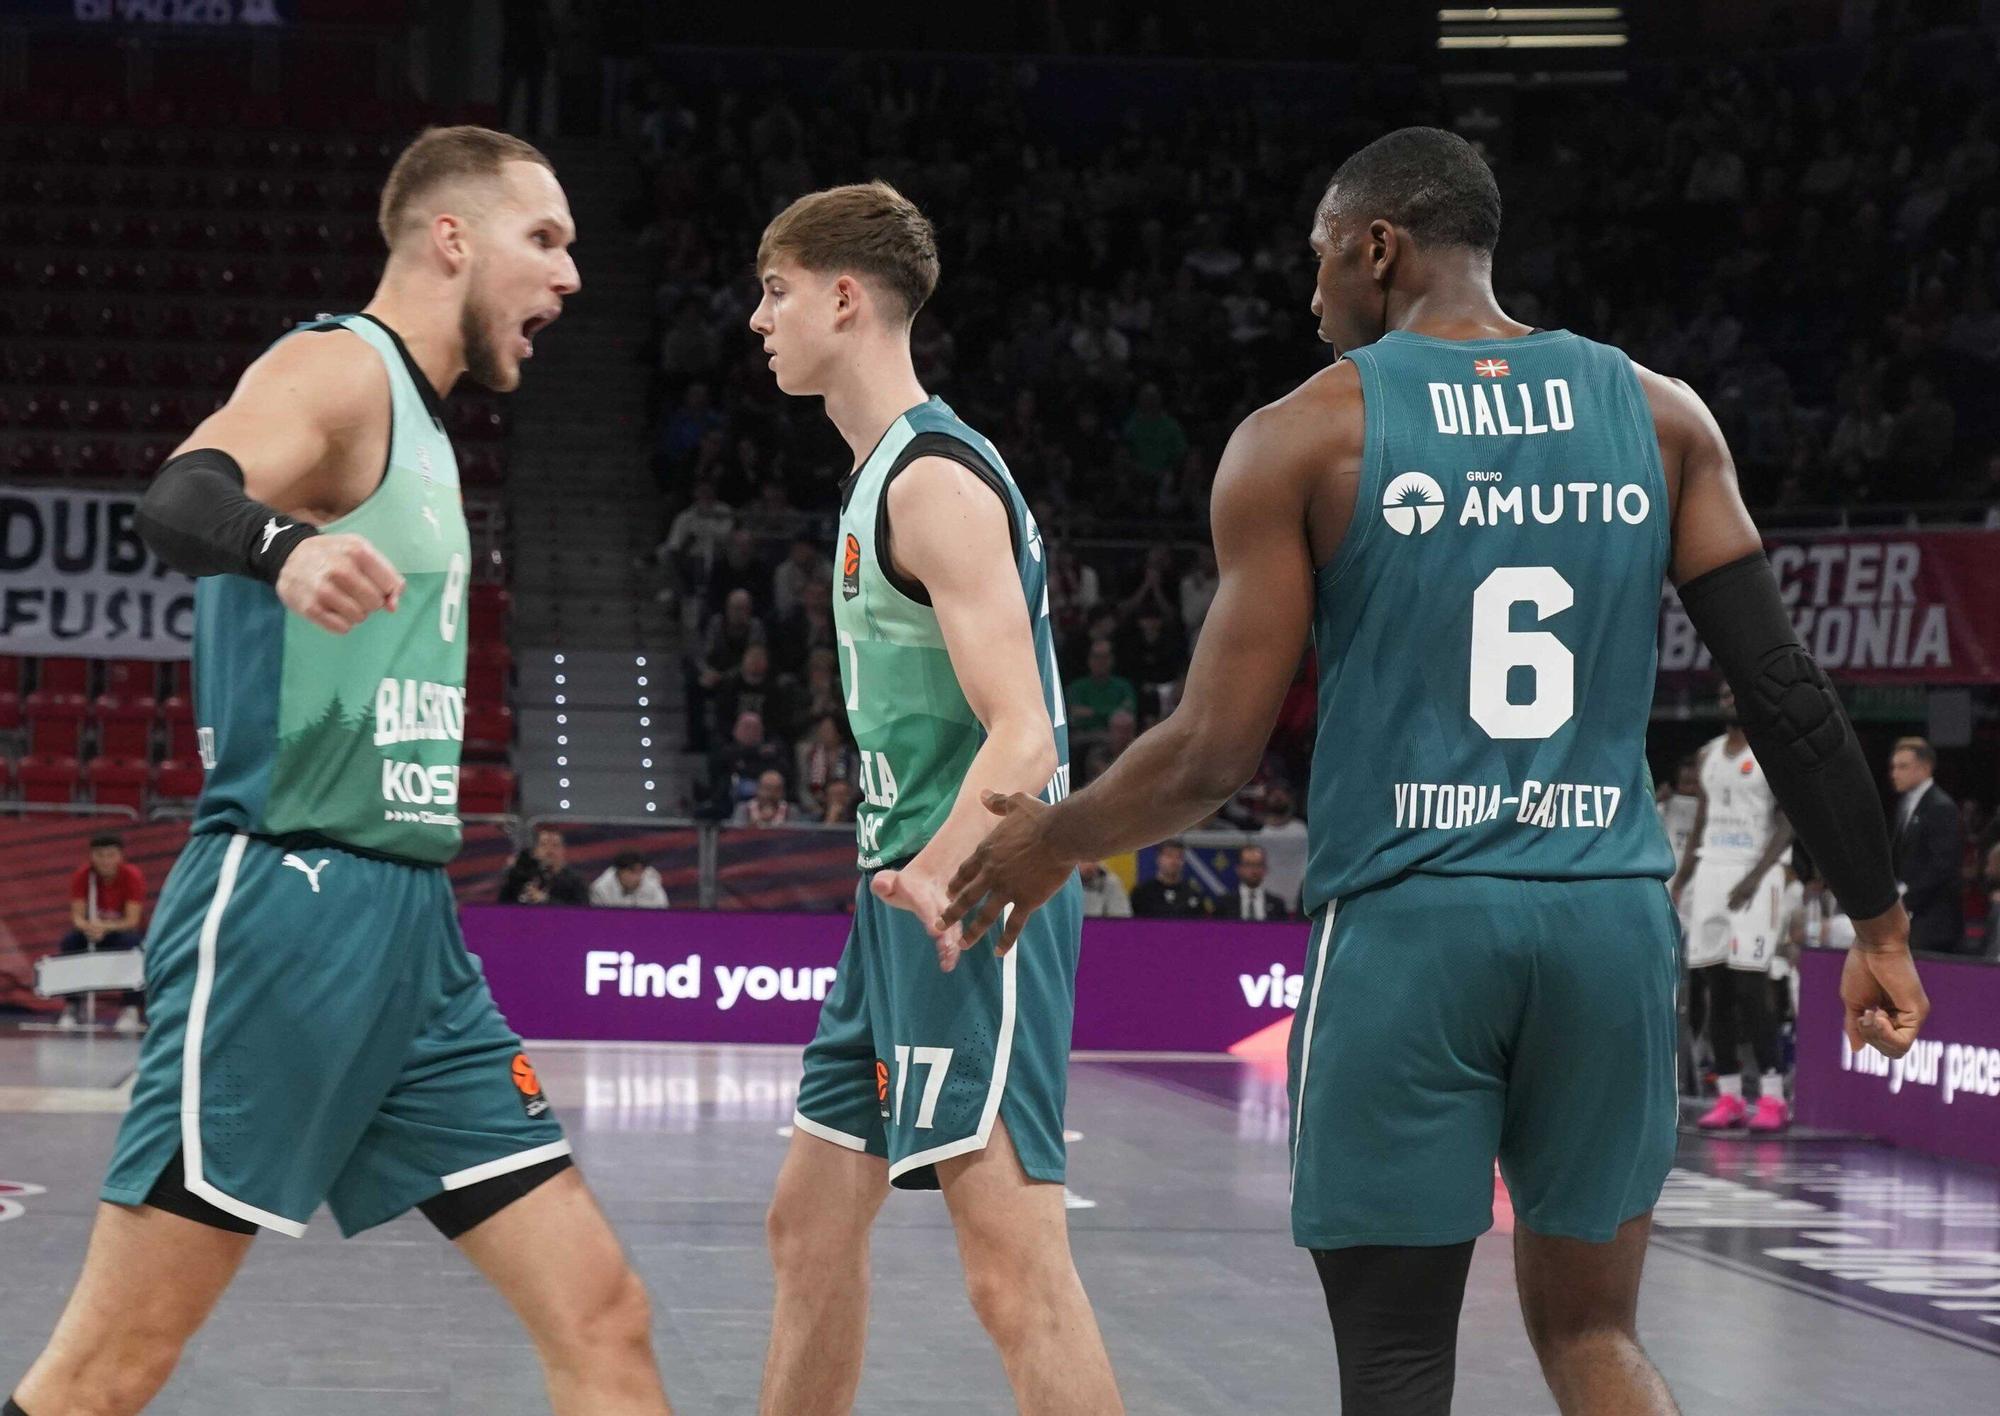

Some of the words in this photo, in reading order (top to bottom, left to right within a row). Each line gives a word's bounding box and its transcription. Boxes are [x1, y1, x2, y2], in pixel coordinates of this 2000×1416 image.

[1428, 378, 1575, 436] DIALLO
[1458, 482, 1651, 527] AMUTIO
[1466, 470, 1503, 483] GRUPO
[0, 497, 197, 580] DUB
[1769, 543, 1922, 604] CTER
[1468, 565, 1575, 739] 6
[382, 758, 460, 805] KOS
[586, 950, 701, 999] Find
[714, 965, 839, 1011] your
[895, 1044, 954, 1129] 17
